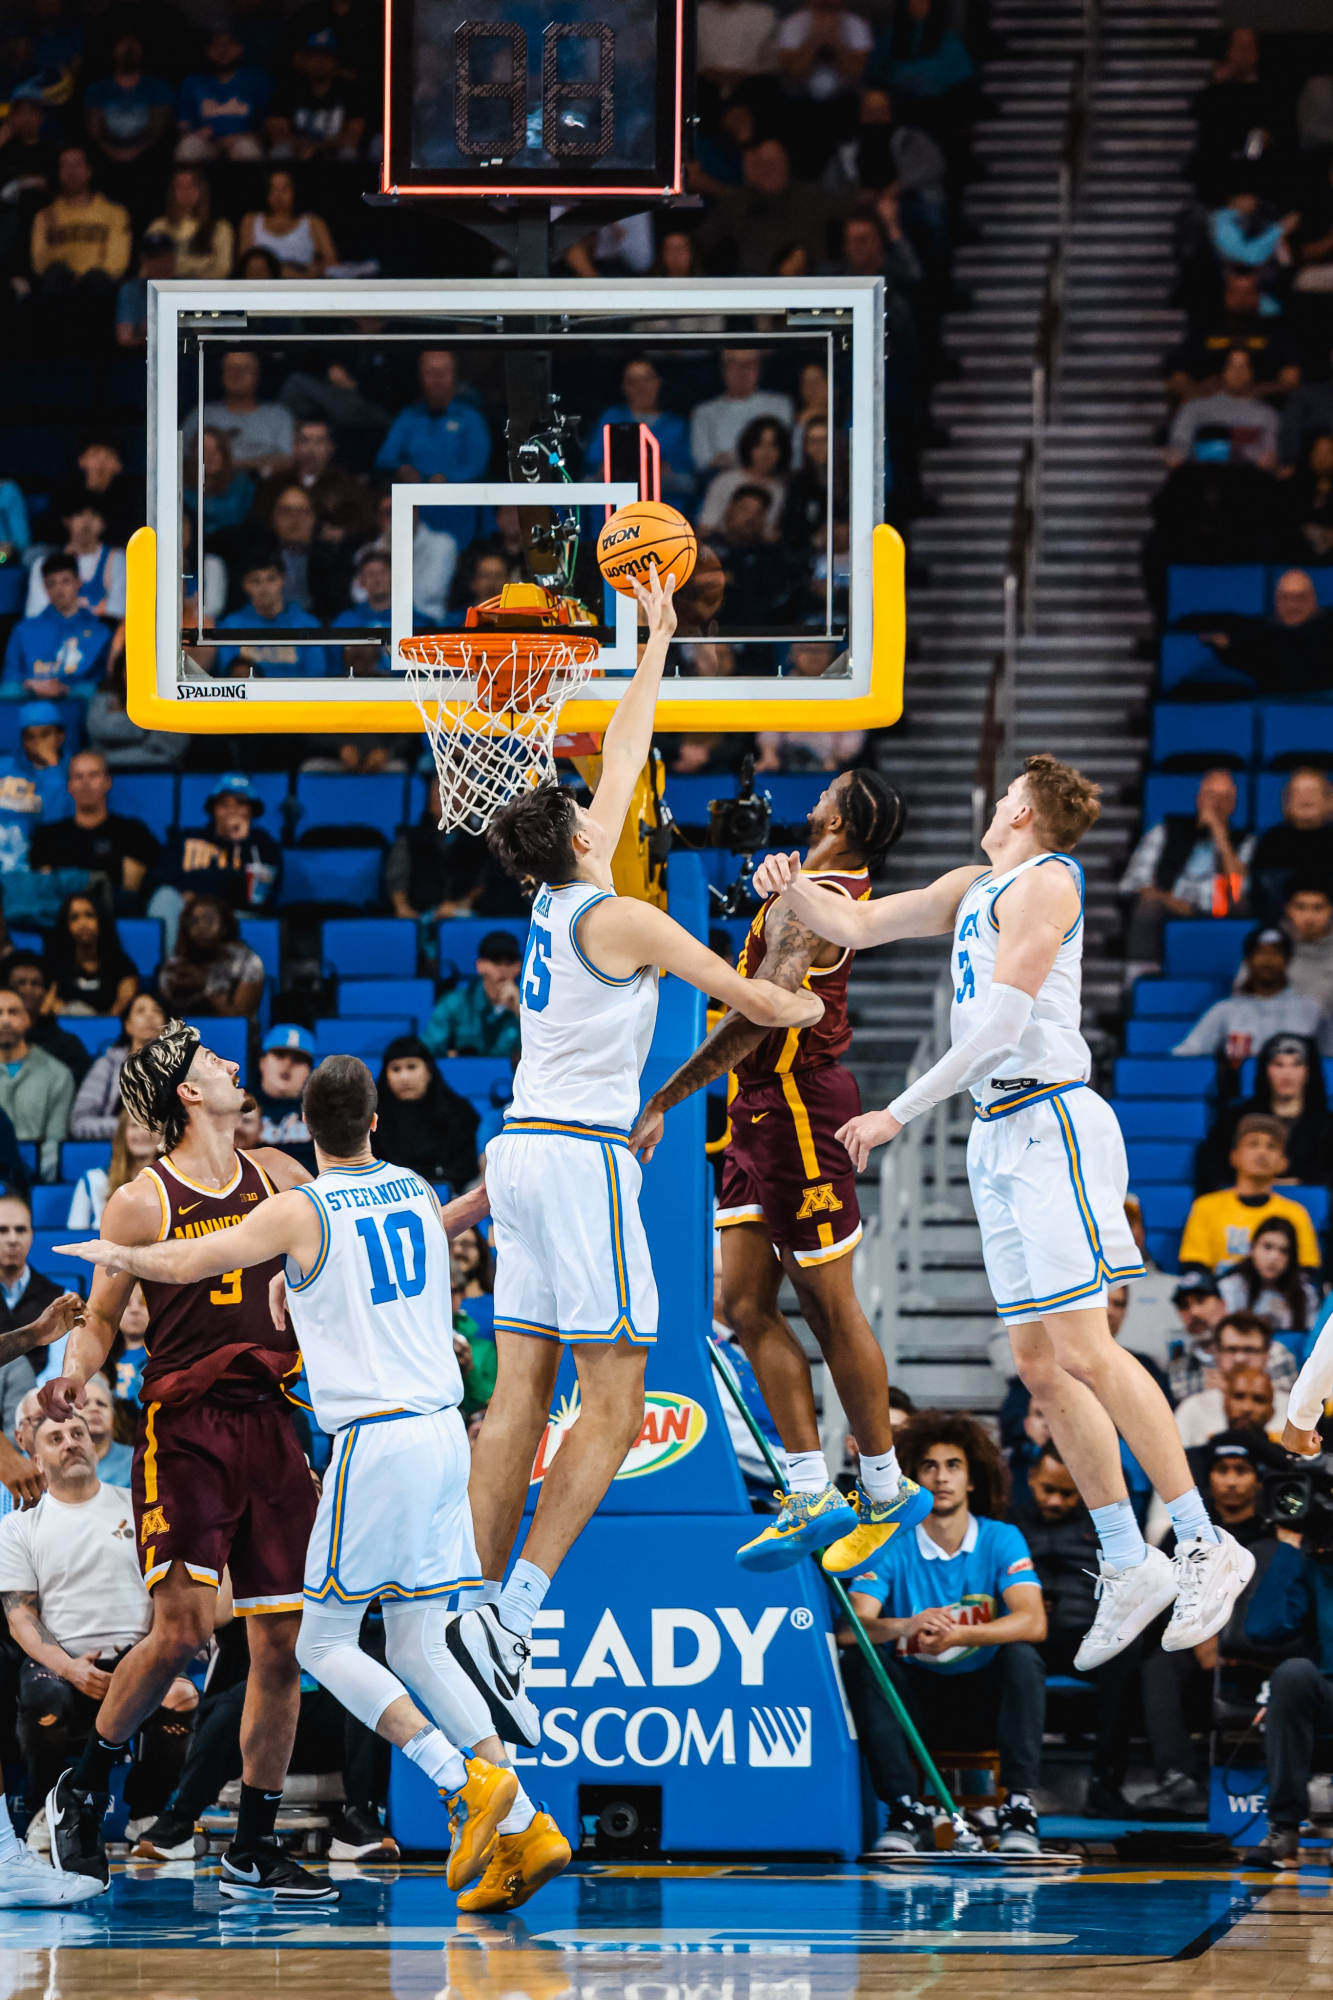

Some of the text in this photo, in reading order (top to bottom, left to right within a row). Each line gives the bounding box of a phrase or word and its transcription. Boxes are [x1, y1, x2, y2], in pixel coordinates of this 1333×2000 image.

[602, 525, 640, 552] NCAA
[604, 550, 663, 578] Wilson
[177, 683, 246, 700] SPALDING
[355, 1210, 427, 1305] 10
[210, 1268, 242, 1305] 3
